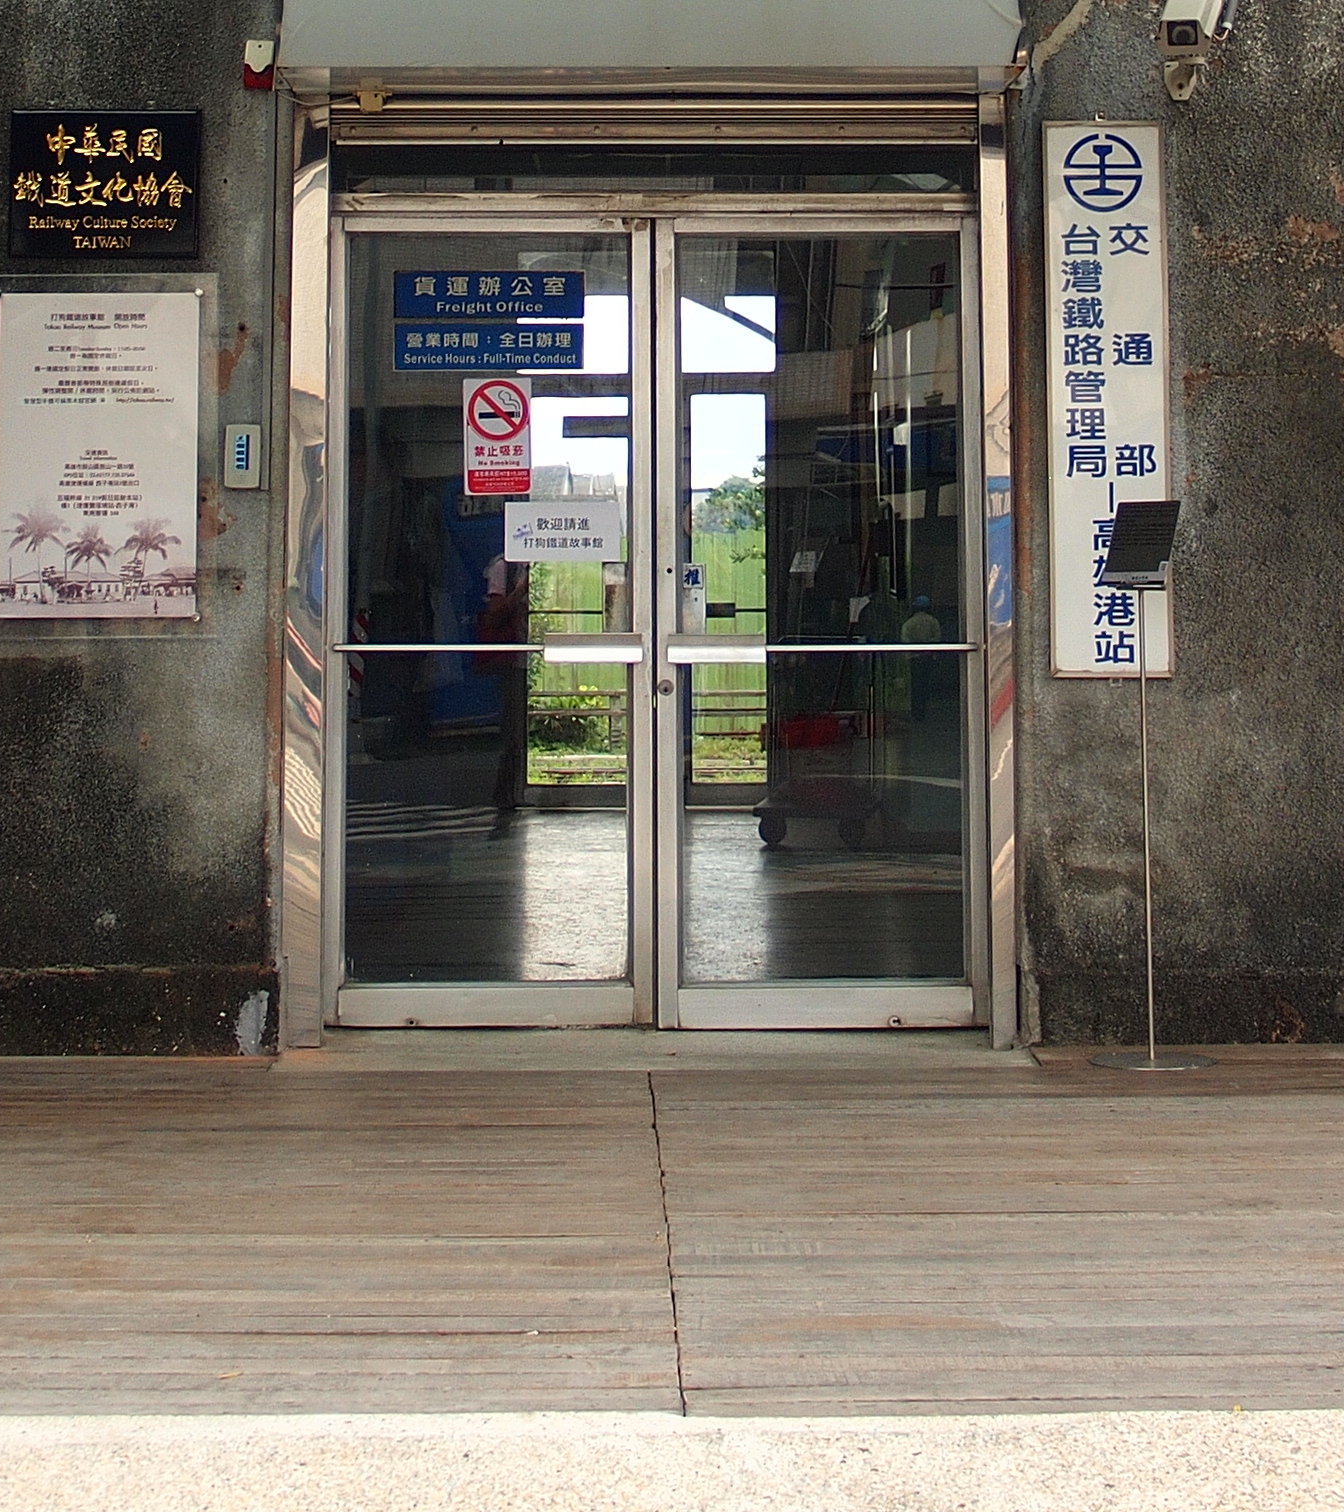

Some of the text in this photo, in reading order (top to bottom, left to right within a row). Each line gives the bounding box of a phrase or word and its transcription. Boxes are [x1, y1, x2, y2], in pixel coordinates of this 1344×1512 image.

[46, 123, 163, 165] 中華民國
[28, 216, 177, 231] Railway Culture Society
[73, 236, 132, 249] TAIWAN
[414, 277, 566, 296] 貨運辦公室
[436, 301, 544, 314] Freight Office
[1061, 223, 1106, 478] 台灣鐵路管理局
[1109, 223, 1157, 477] 交通部
[404, 353, 443, 364] Service
[483, 353, 531, 364] Full-Time
[533, 353, 576, 364] Conduct
[474, 445, 524, 457] 禁止吸菸
[537, 517, 590, 531] 歡迎請進
[684, 568, 701, 586] 推
